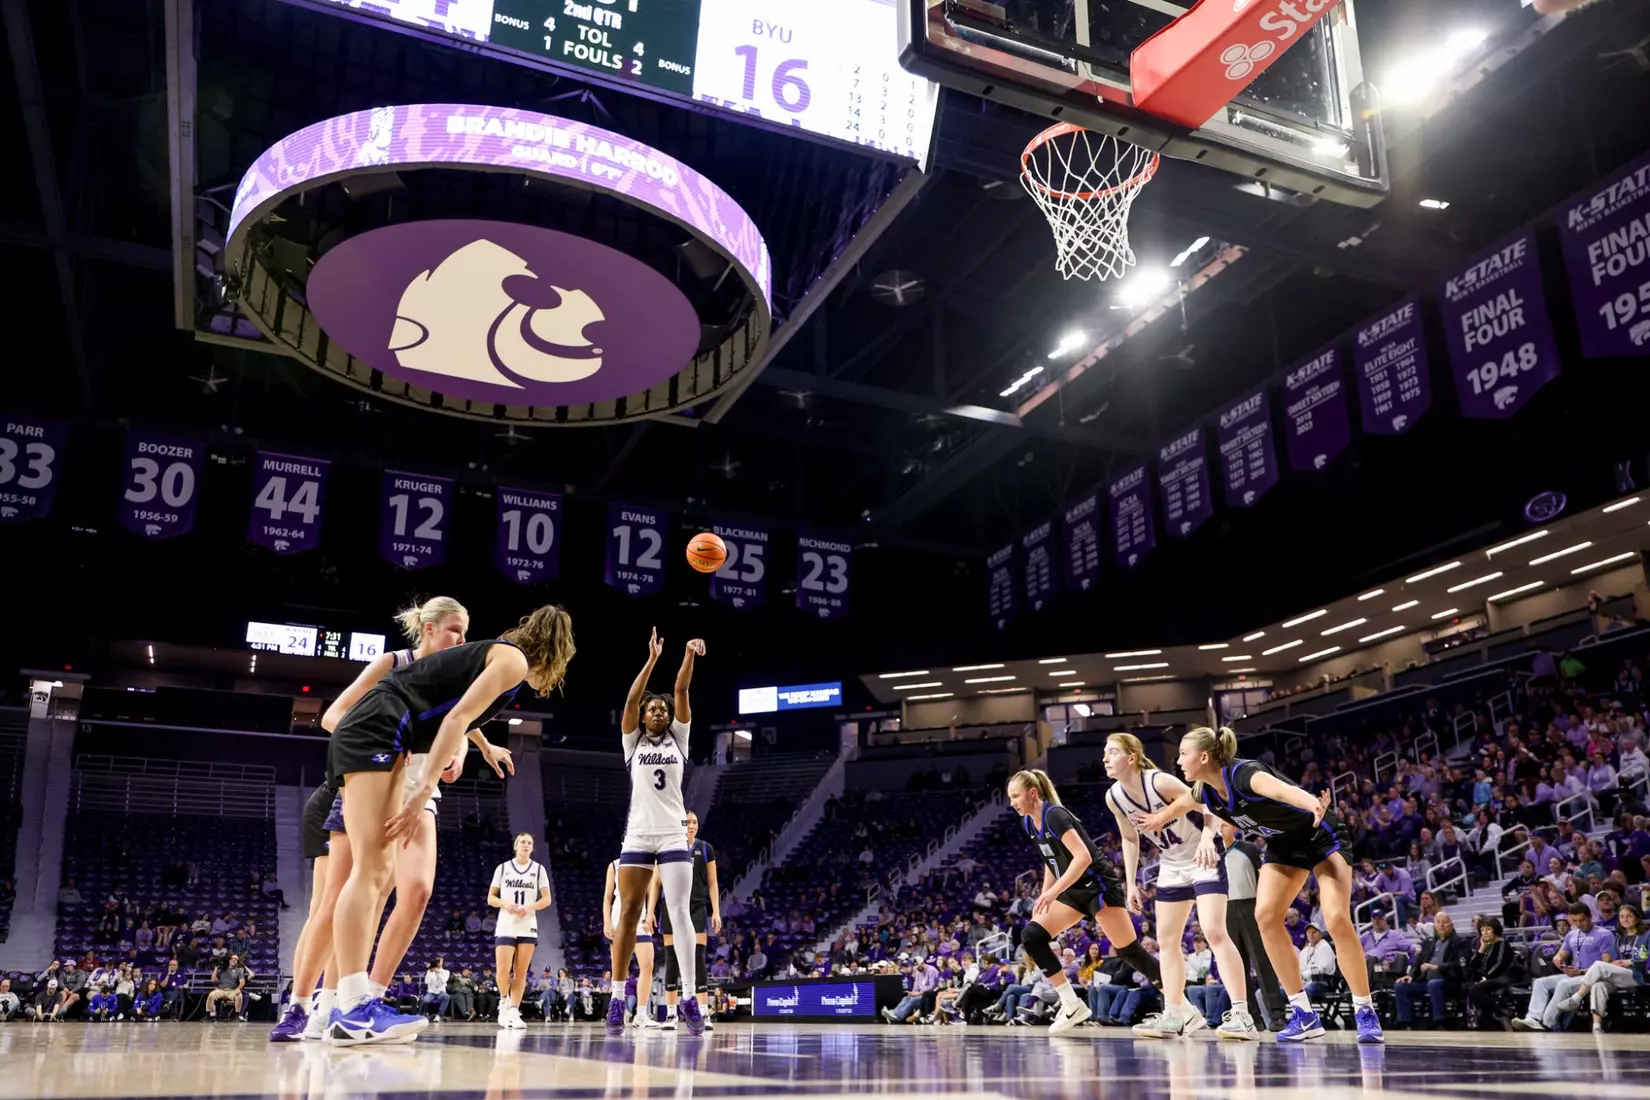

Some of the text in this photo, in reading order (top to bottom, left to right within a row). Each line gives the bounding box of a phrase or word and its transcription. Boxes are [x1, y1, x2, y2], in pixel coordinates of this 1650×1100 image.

[494, 13, 530, 30] BONUS
[563, 1, 591, 21] 2nd
[593, 6, 622, 30] QTR
[544, 17, 645, 57] 4 TOL 4
[752, 19, 792, 43] BYU
[543, 36, 642, 75] 1 FOULS 2
[658, 58, 691, 75] BONUS
[735, 45, 811, 113] 16
[854, 64, 860, 74] 2
[882, 73, 889, 82] 0
[849, 92, 914, 118] 13 2 0
[853, 79, 915, 105] 7 3 2
[848, 106, 860, 117] 14
[907, 122, 913, 132] 0
[846, 120, 912, 146] 24 0 0
[446, 115, 678, 187] BRANDIE HARROD
[511, 145, 577, 169] GUARD
[1568, 164, 1650, 229] K-STAT
[1604, 184, 1650, 217] BASKETBA
[1445, 237, 1527, 298] K-STATE
[1592, 237, 1650, 287] FOU
[1357, 302, 1414, 345] K-STATE
[1461, 288, 1524, 333] FINAL
[1464, 307, 1525, 353] FOUR
[1363, 337, 1415, 373] ELITE EIGHT
[1286, 349, 1335, 388] K-STATE
[1466, 342, 1538, 395] 1948
[1220, 392, 1263, 426] K-STATE
[6, 422, 44, 438] PARR
[138, 442, 193, 458] BOOZER
[1160, 428, 1200, 460] K-STATE
[263, 459, 322, 477] MURRELL
[124, 457, 195, 507] 30
[394, 478, 442, 494] KRUGER
[254, 475, 320, 524] 44
[502, 494, 557, 510] WILLIAMS
[133, 510, 178, 523] 1956-59
[388, 494, 444, 540] 12
[621, 511, 656, 525] EVANS
[263, 526, 305, 540] 1962-64
[502, 509, 554, 555] 10
[713, 525, 768, 542] BLACKMAN
[799, 537, 851, 553] RICHMOND
[392, 542, 432, 555] 1971-74
[613, 524, 662, 570] 12
[506, 557, 544, 569] 1972-76
[715, 540, 765, 583] 25
[801, 552, 848, 594] 23
[287, 635, 308, 650] 24
[325, 631, 341, 641] 7:31
[358, 643, 377, 656] 16
[638, 752, 678, 766] Wildcats
[653, 769, 666, 790] 3
[505, 879, 535, 890] Wildcats
[514, 891, 525, 905] 11
